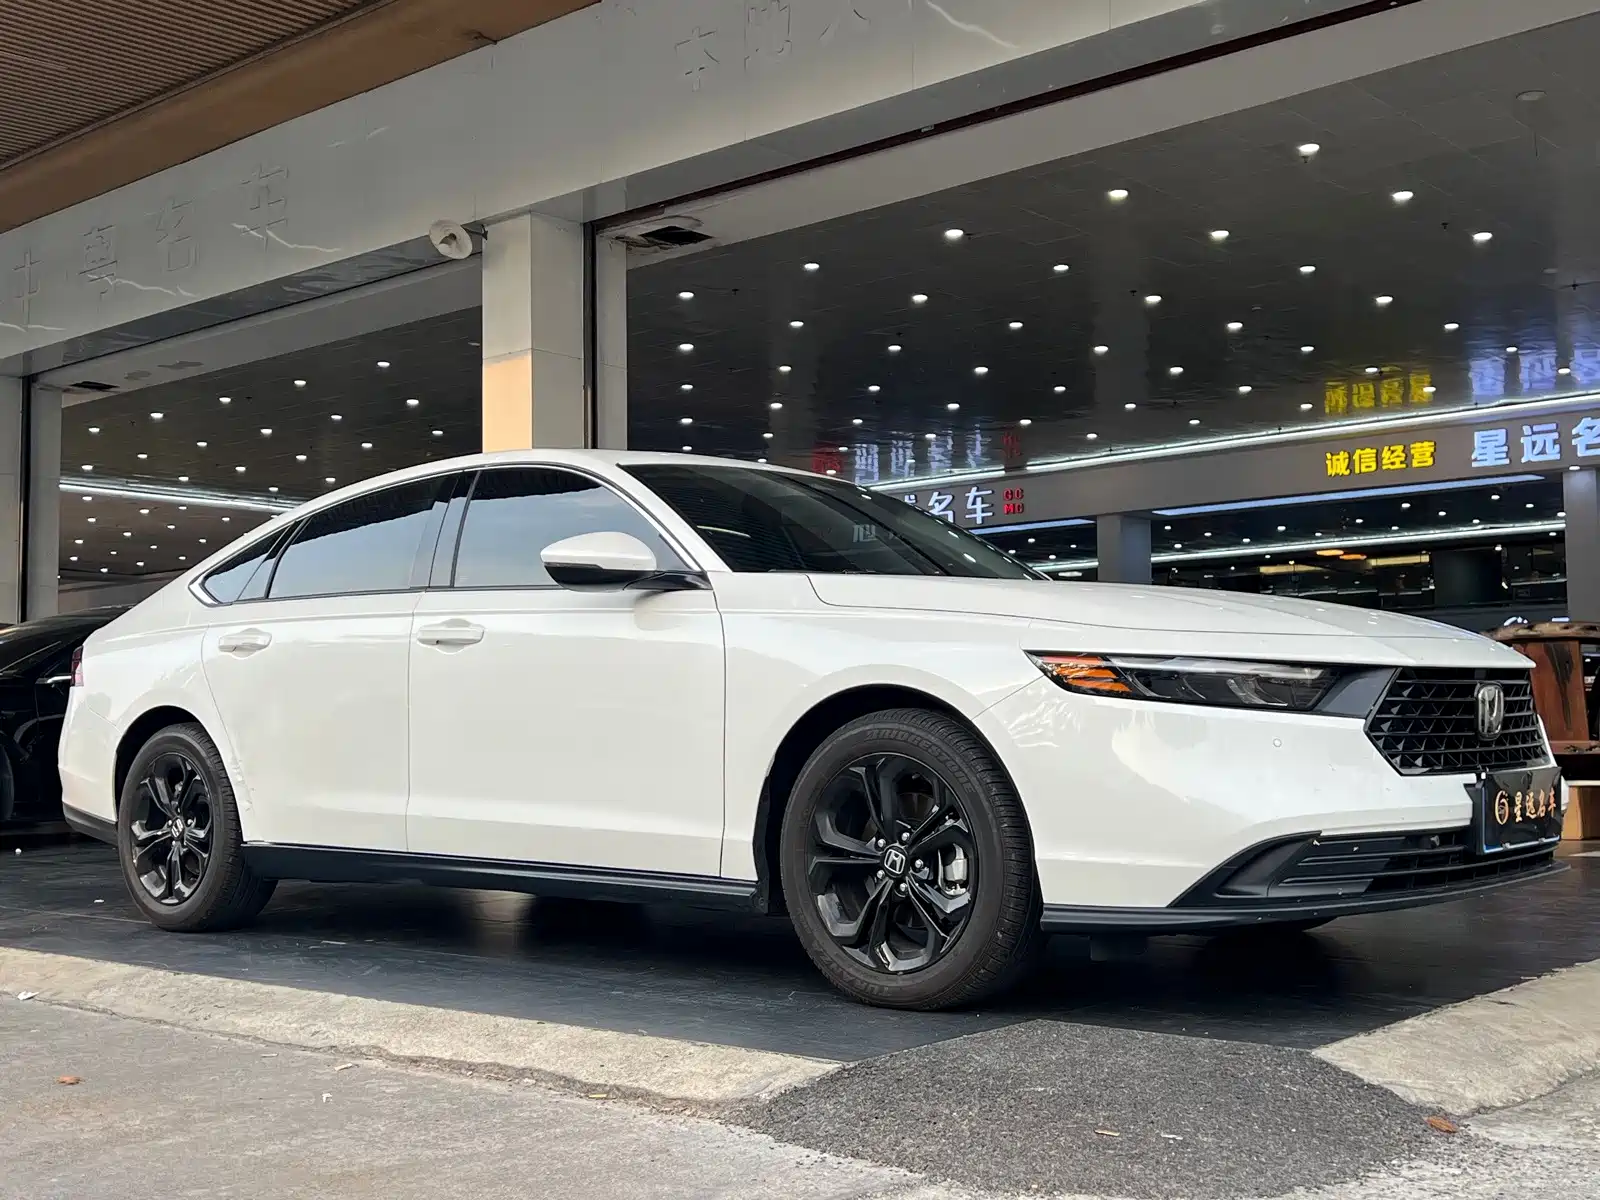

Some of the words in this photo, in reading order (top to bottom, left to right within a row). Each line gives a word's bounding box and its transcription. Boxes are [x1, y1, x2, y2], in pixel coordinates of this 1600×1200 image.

[1326, 441, 1435, 476] 诚信经营
[1472, 417, 1600, 467] 星远名
[904, 486, 993, 524] 名车
[863, 729, 975, 792] BRIDGESTONE
